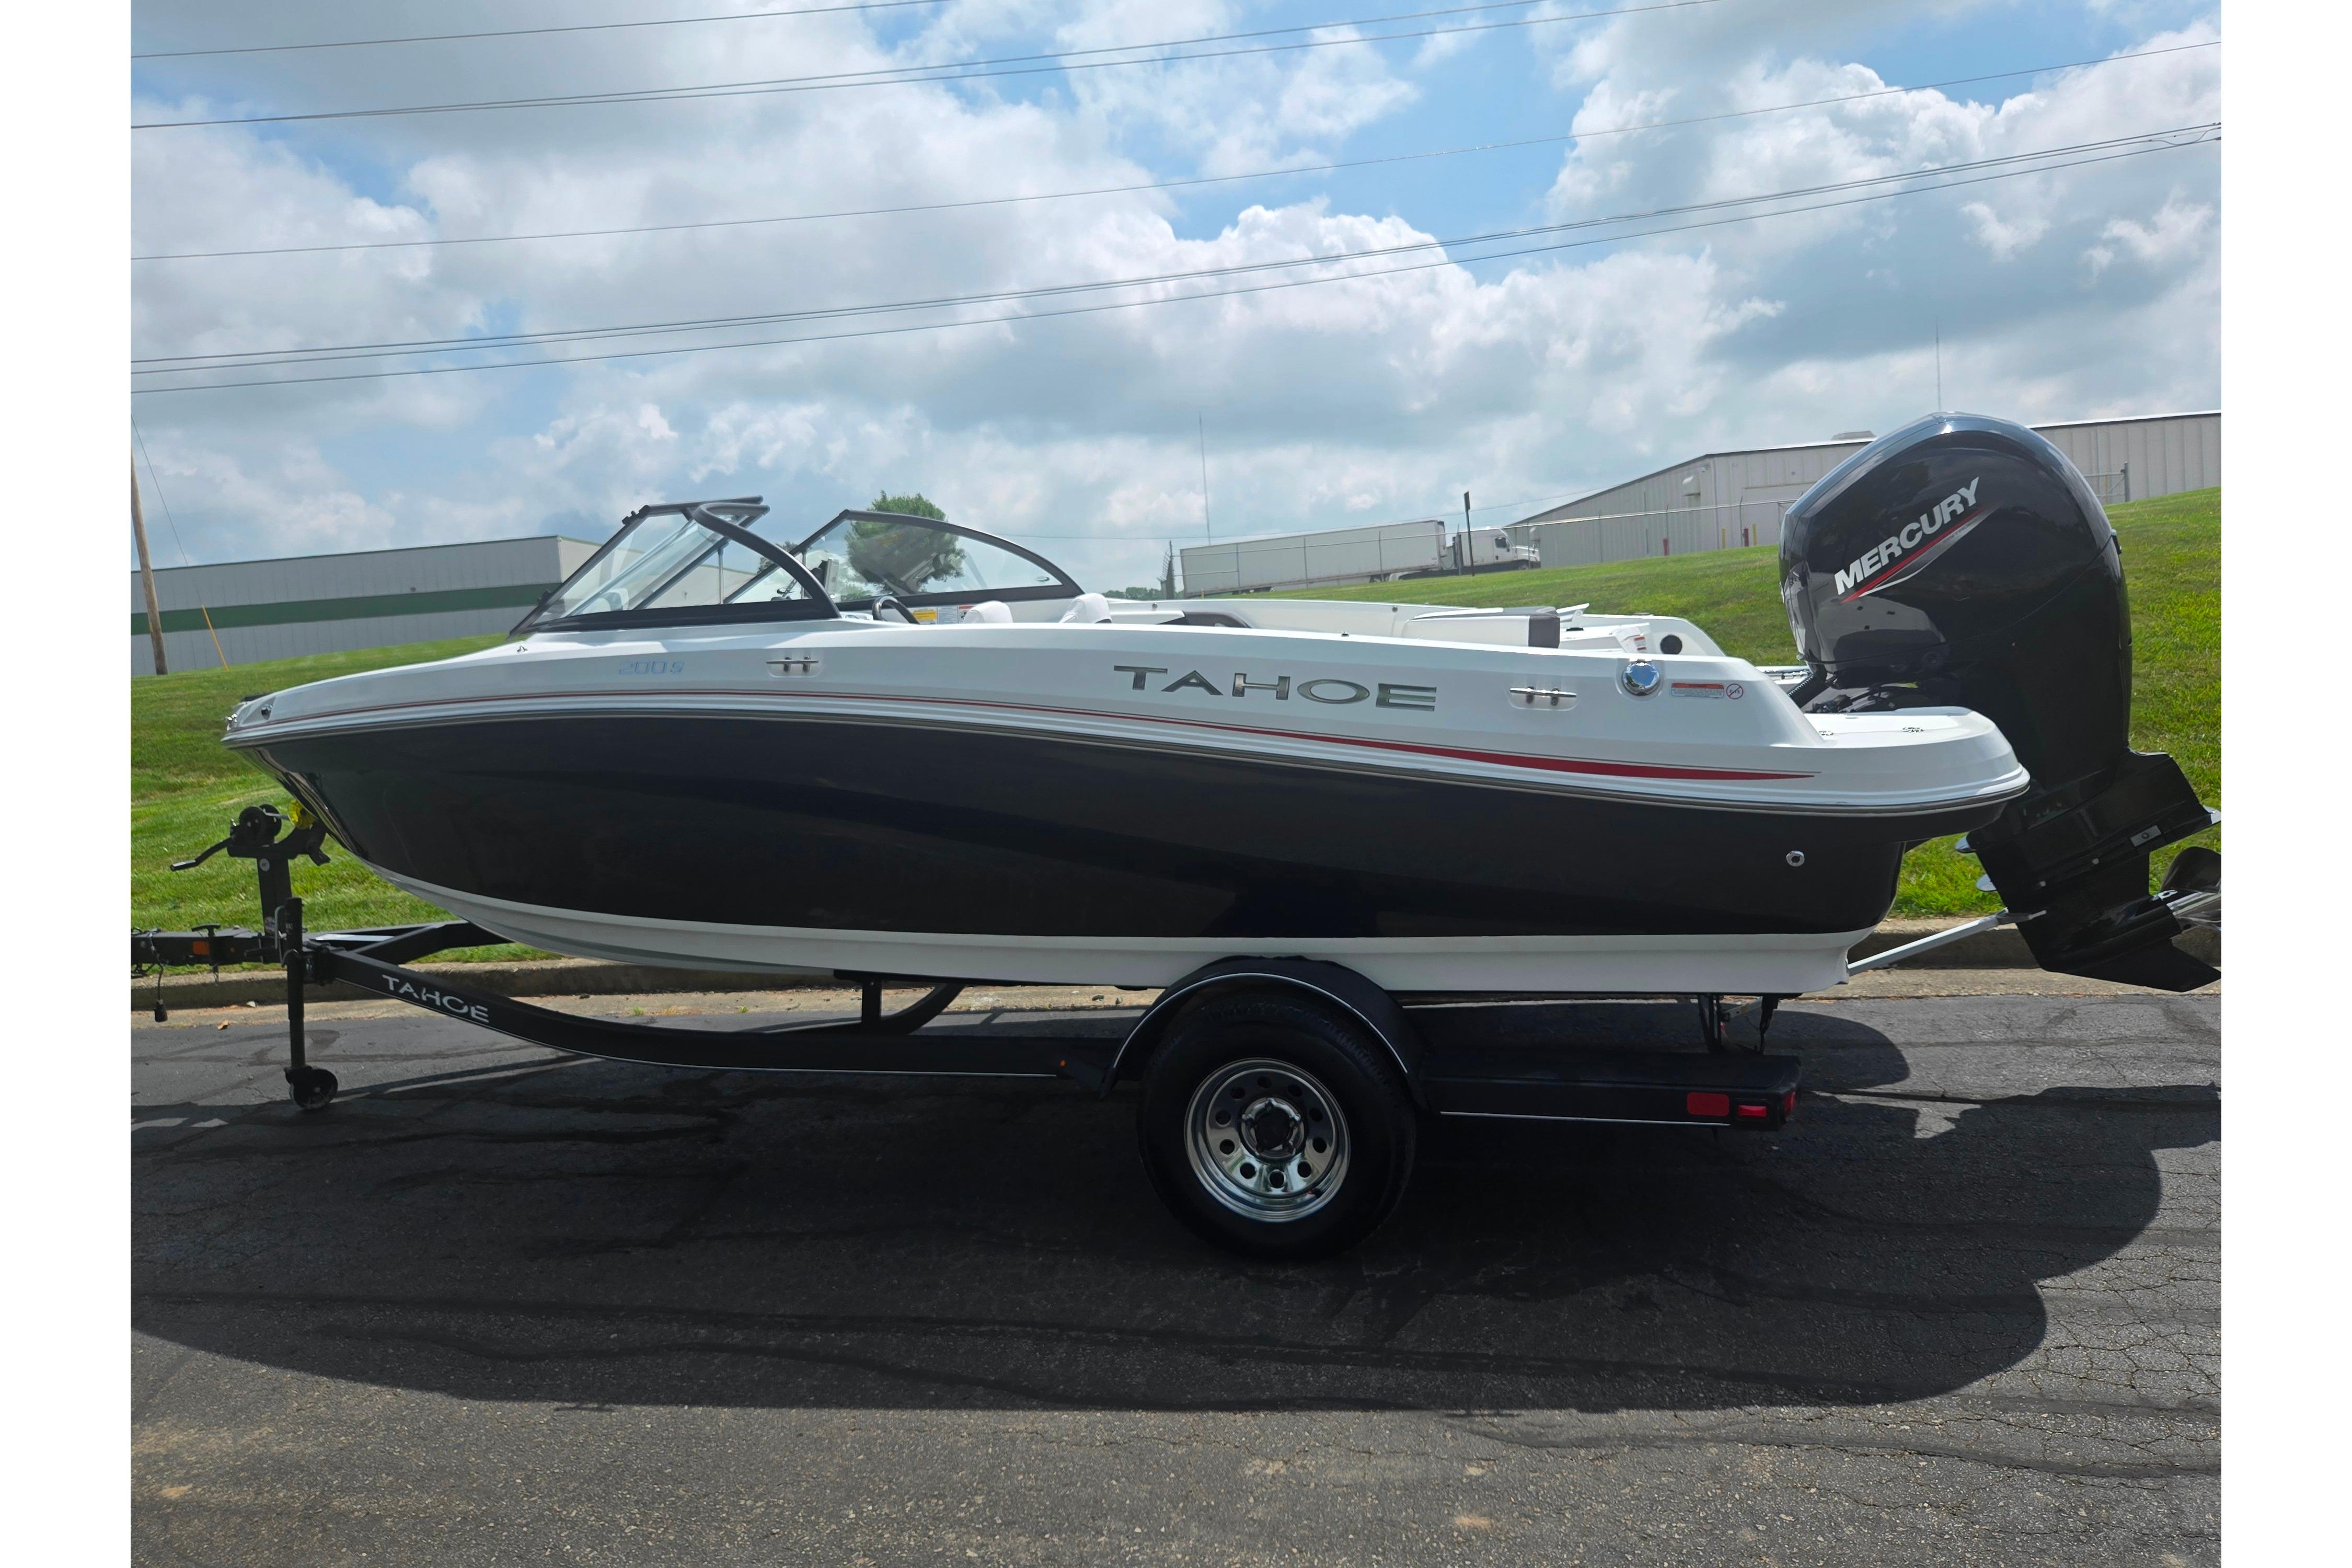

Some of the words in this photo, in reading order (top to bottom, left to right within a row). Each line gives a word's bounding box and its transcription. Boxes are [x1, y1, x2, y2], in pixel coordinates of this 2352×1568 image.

[1834, 476, 1979, 595] MERCURY
[619, 660, 667, 675] 200
[1114, 665, 1437, 711] TAHOE
[382, 975, 489, 1023] TAHOE
